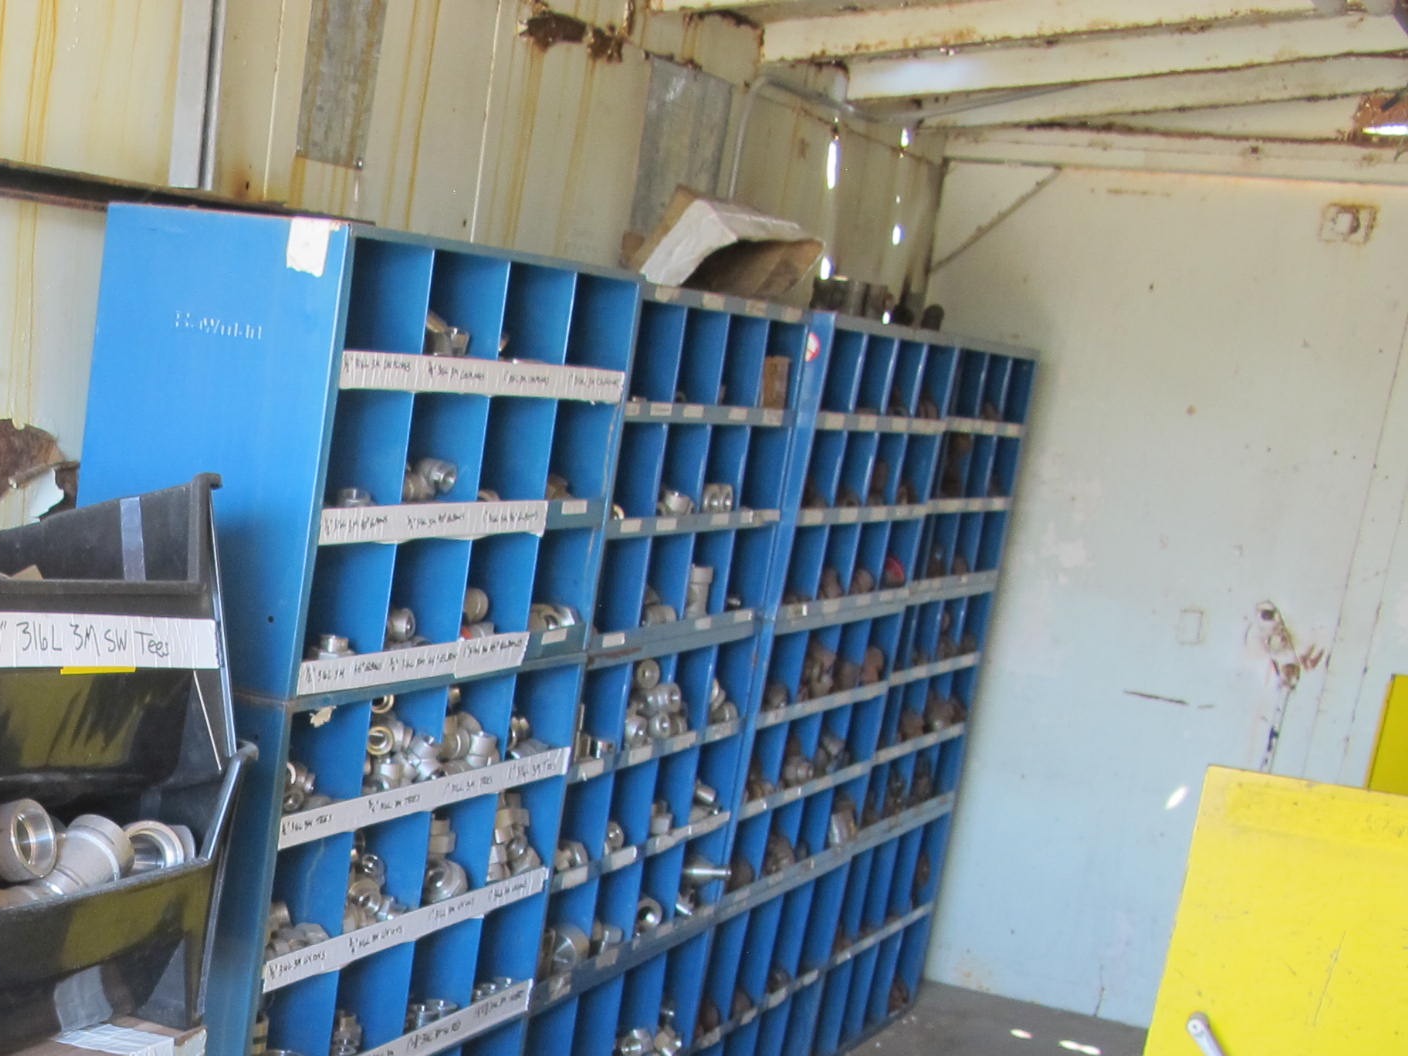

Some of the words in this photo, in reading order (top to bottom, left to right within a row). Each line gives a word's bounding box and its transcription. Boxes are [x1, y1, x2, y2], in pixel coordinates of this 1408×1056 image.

[16, 621, 63, 652] 316L
[69, 623, 100, 656] 3M
[104, 628, 128, 654] SW
[134, 630, 170, 658] Tees
